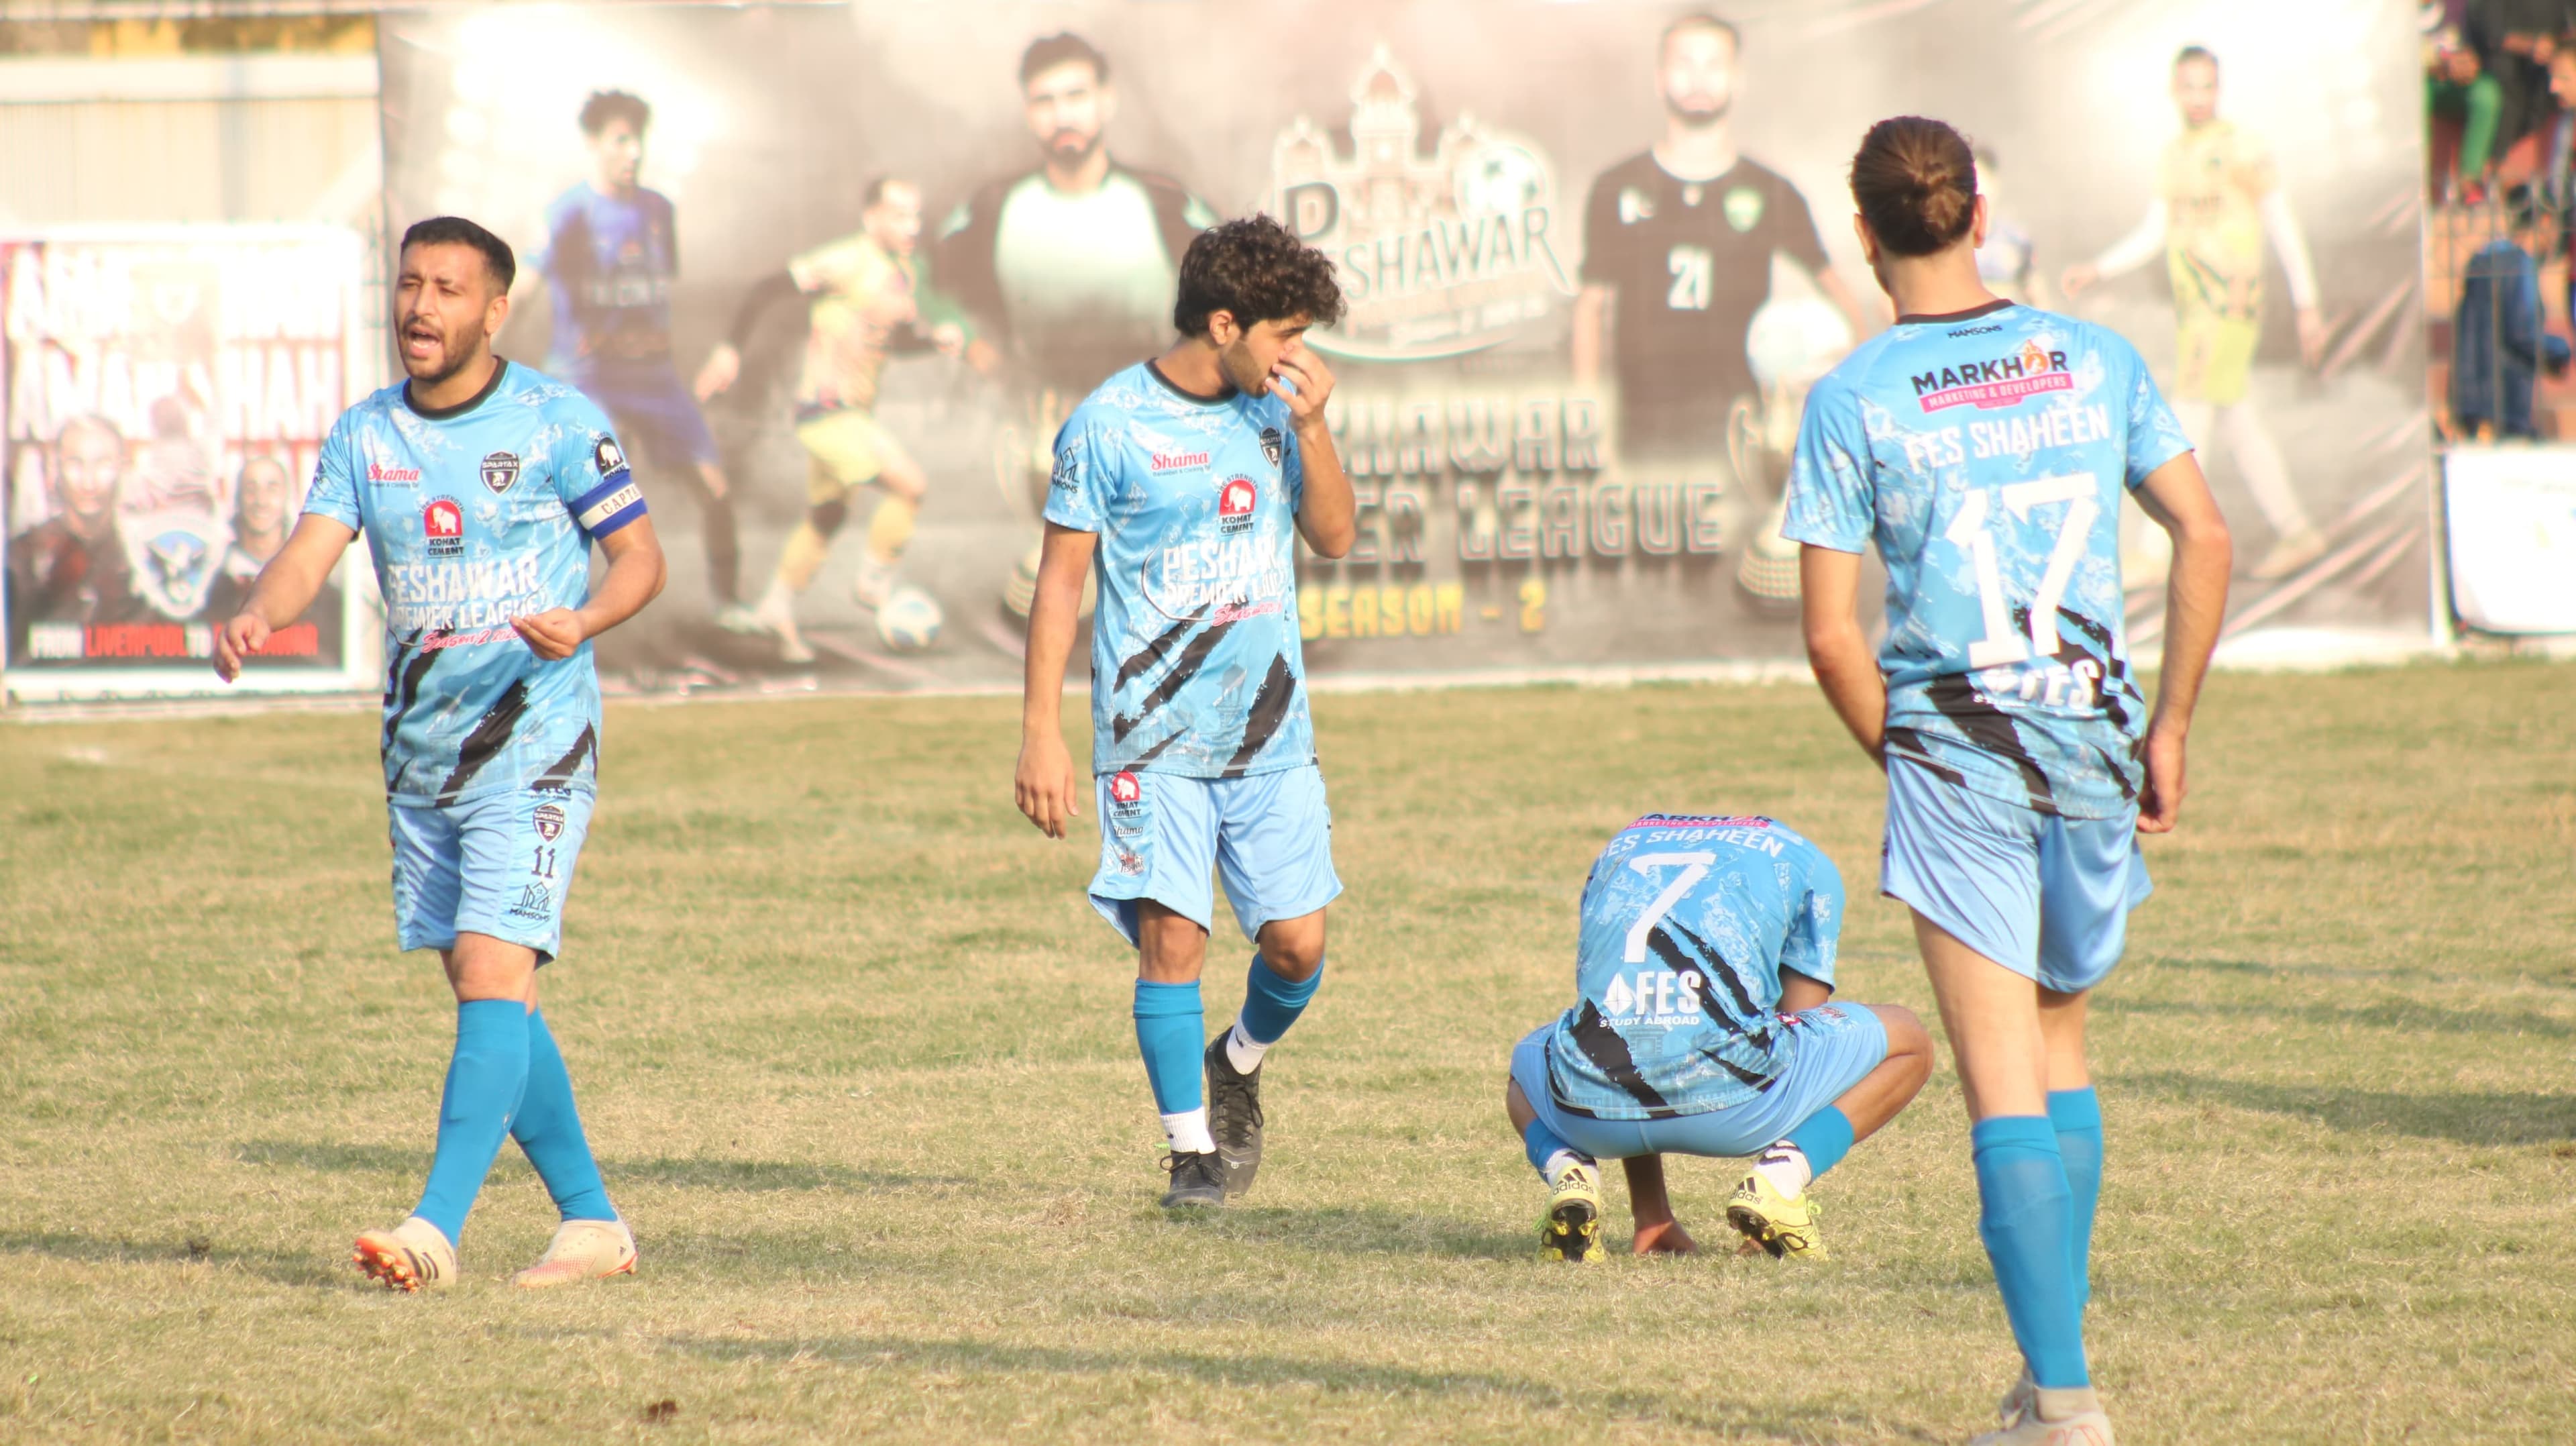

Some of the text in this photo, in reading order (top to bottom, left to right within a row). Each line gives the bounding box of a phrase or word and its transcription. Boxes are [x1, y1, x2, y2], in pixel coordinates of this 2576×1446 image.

[1283, 180, 1571, 299] PSHAWAR
[1668, 245, 1711, 310] 21
[1948, 325, 2002, 338] MAMSONS
[1911, 349, 2069, 396] MARKHOR
[1928, 376, 2067, 409] MARKETING & DEVELOPERS
[1324, 397, 1605, 475] HAWAR
[1902, 405, 2110, 473] FES SHAHEEN
[1151, 452, 1209, 470] Shama
[1217, 473, 1258, 495] THE STRENGTH
[1220, 523, 1254, 533] CEMENT
[1222, 514, 1252, 525] KOHAT
[1458, 480, 1723, 562] LEAGUE
[427, 547, 464, 556] CEMENT
[429, 537, 460, 546] KOHAT
[1945, 472, 2100, 669] 17
[392, 605, 456, 630] REMIER
[1299, 582, 1464, 641] SEASON
[1518, 580, 1547, 633] 2
[30, 623, 83, 660] FROM
[1607, 829, 1784, 858] ES SHAHEEN
[531, 845, 555, 878] 11
[509, 908, 551, 922] MAMSONS
[1623, 852, 1717, 963] 7
[1635, 970, 1701, 1015] FES
[1599, 1016, 1700, 1029] STUDY ABROAD
[1552, 1181, 1594, 1196] adidas
[1730, 1190, 1762, 1205] didas
